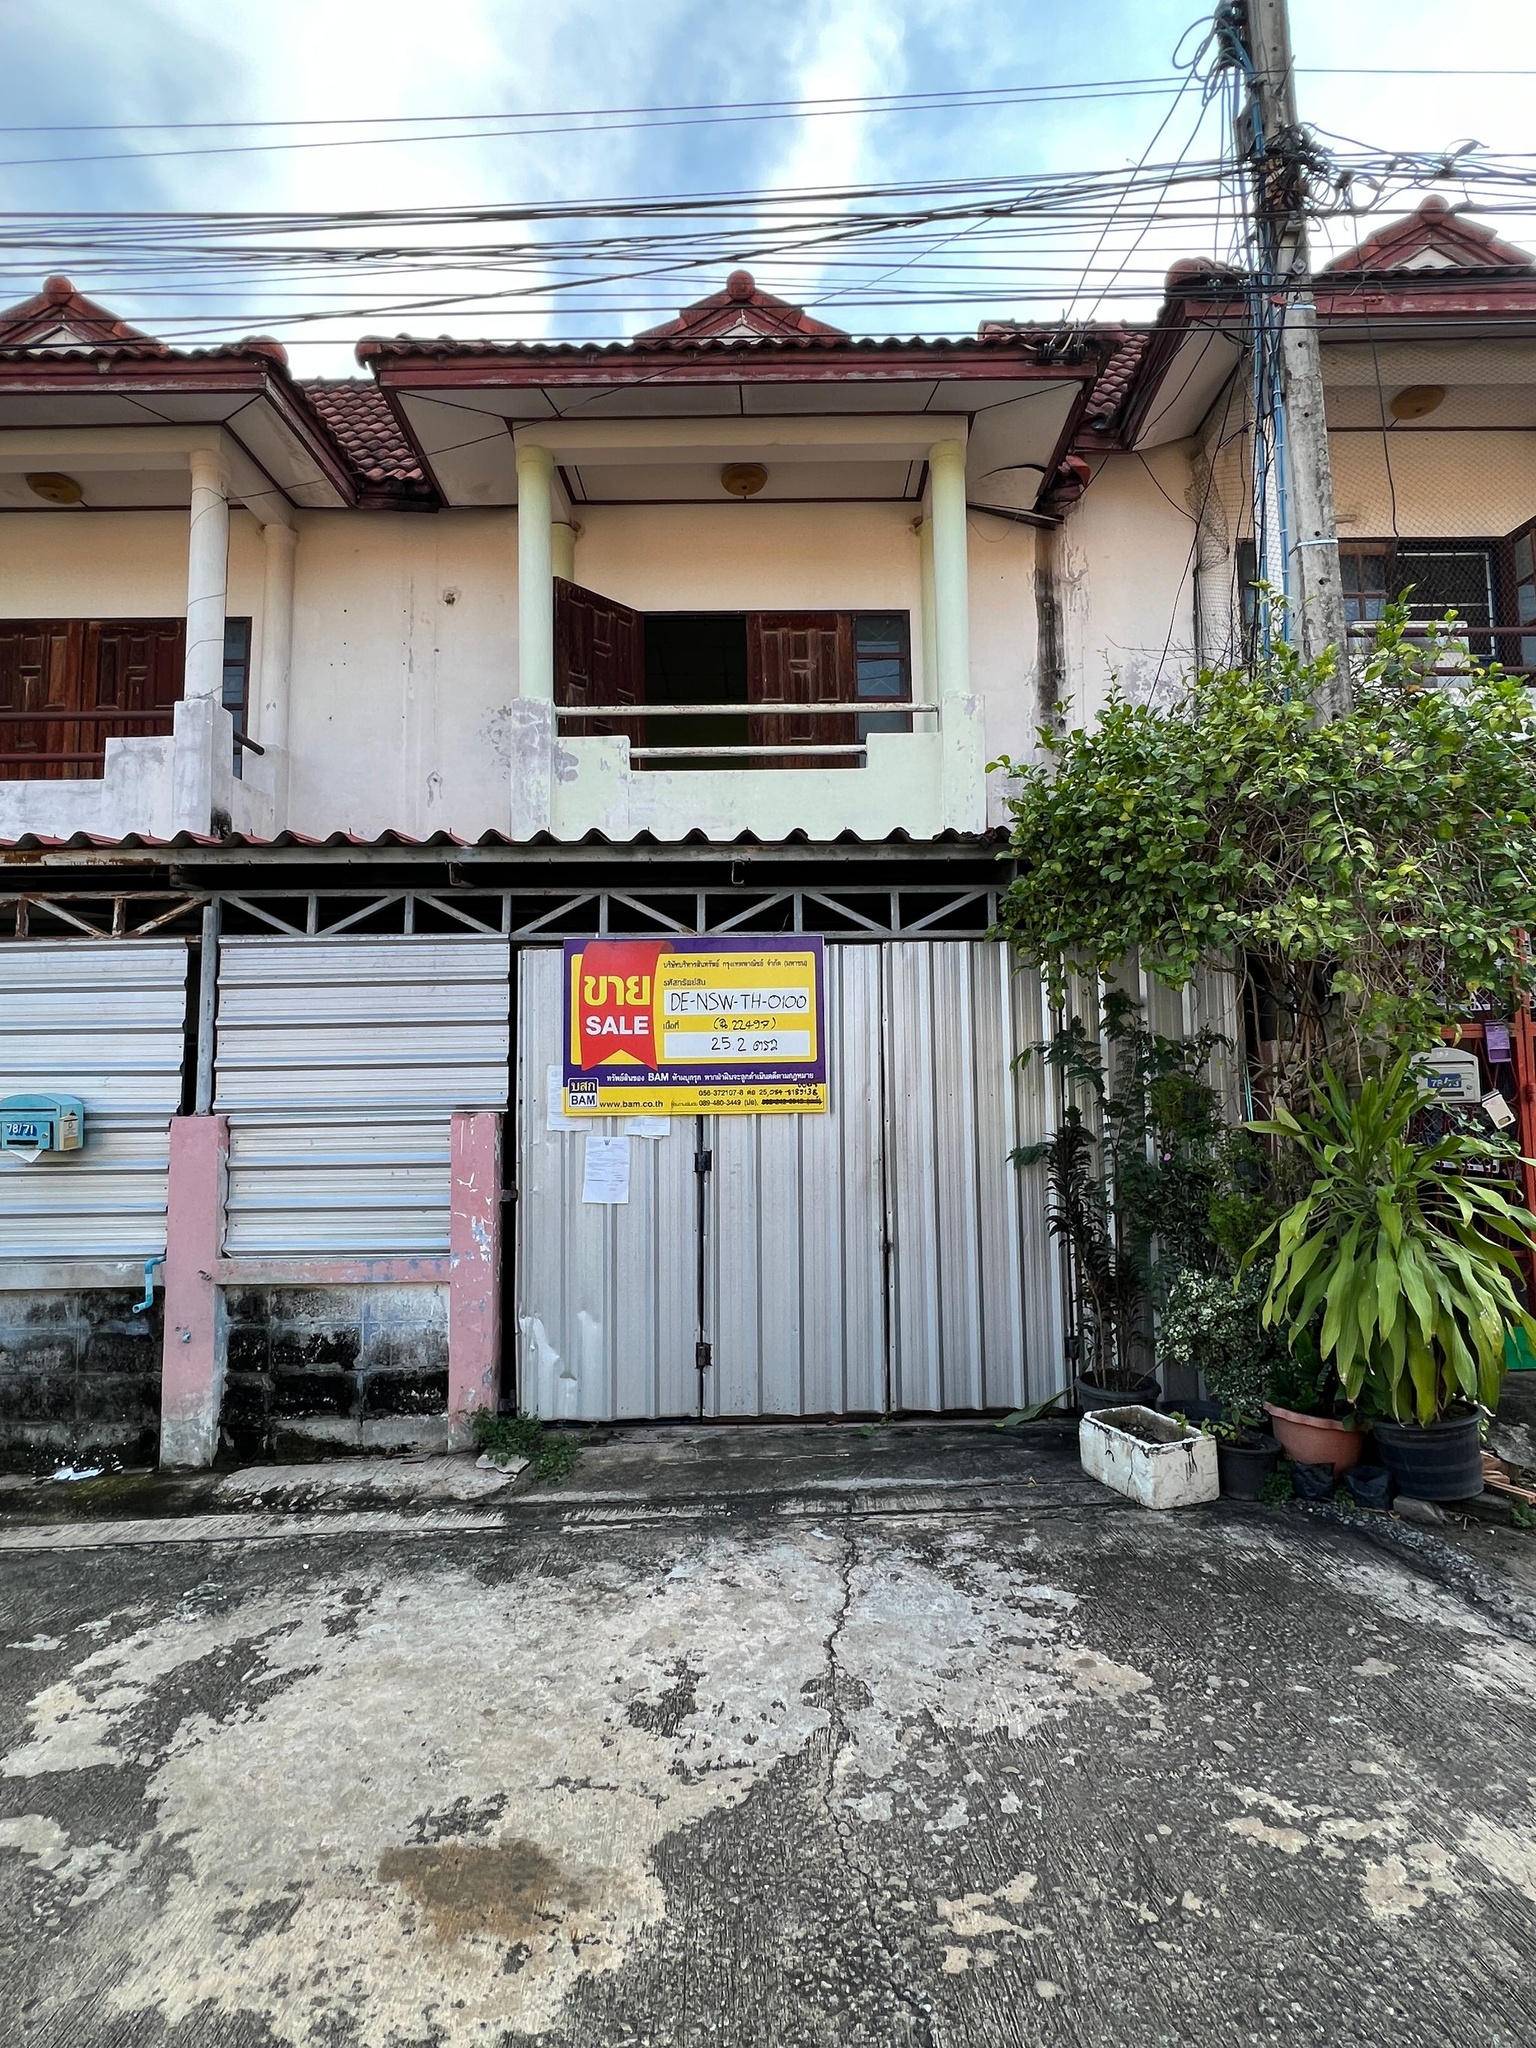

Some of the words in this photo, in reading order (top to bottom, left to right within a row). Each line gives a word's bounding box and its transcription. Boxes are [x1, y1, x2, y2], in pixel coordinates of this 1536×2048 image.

[584, 975, 651, 1006] ขาย
[670, 991, 807, 1012] DE-NSW-TH-0100
[585, 1016, 649, 1035] SALE
[648, 1072, 669, 1081] BAM
[571, 1081, 596, 1092] บสก
[571, 1095, 596, 1106] BAM
[599, 1100, 663, 1108] www.bam.co.th
[7, 1123, 34, 1135] 78/71
